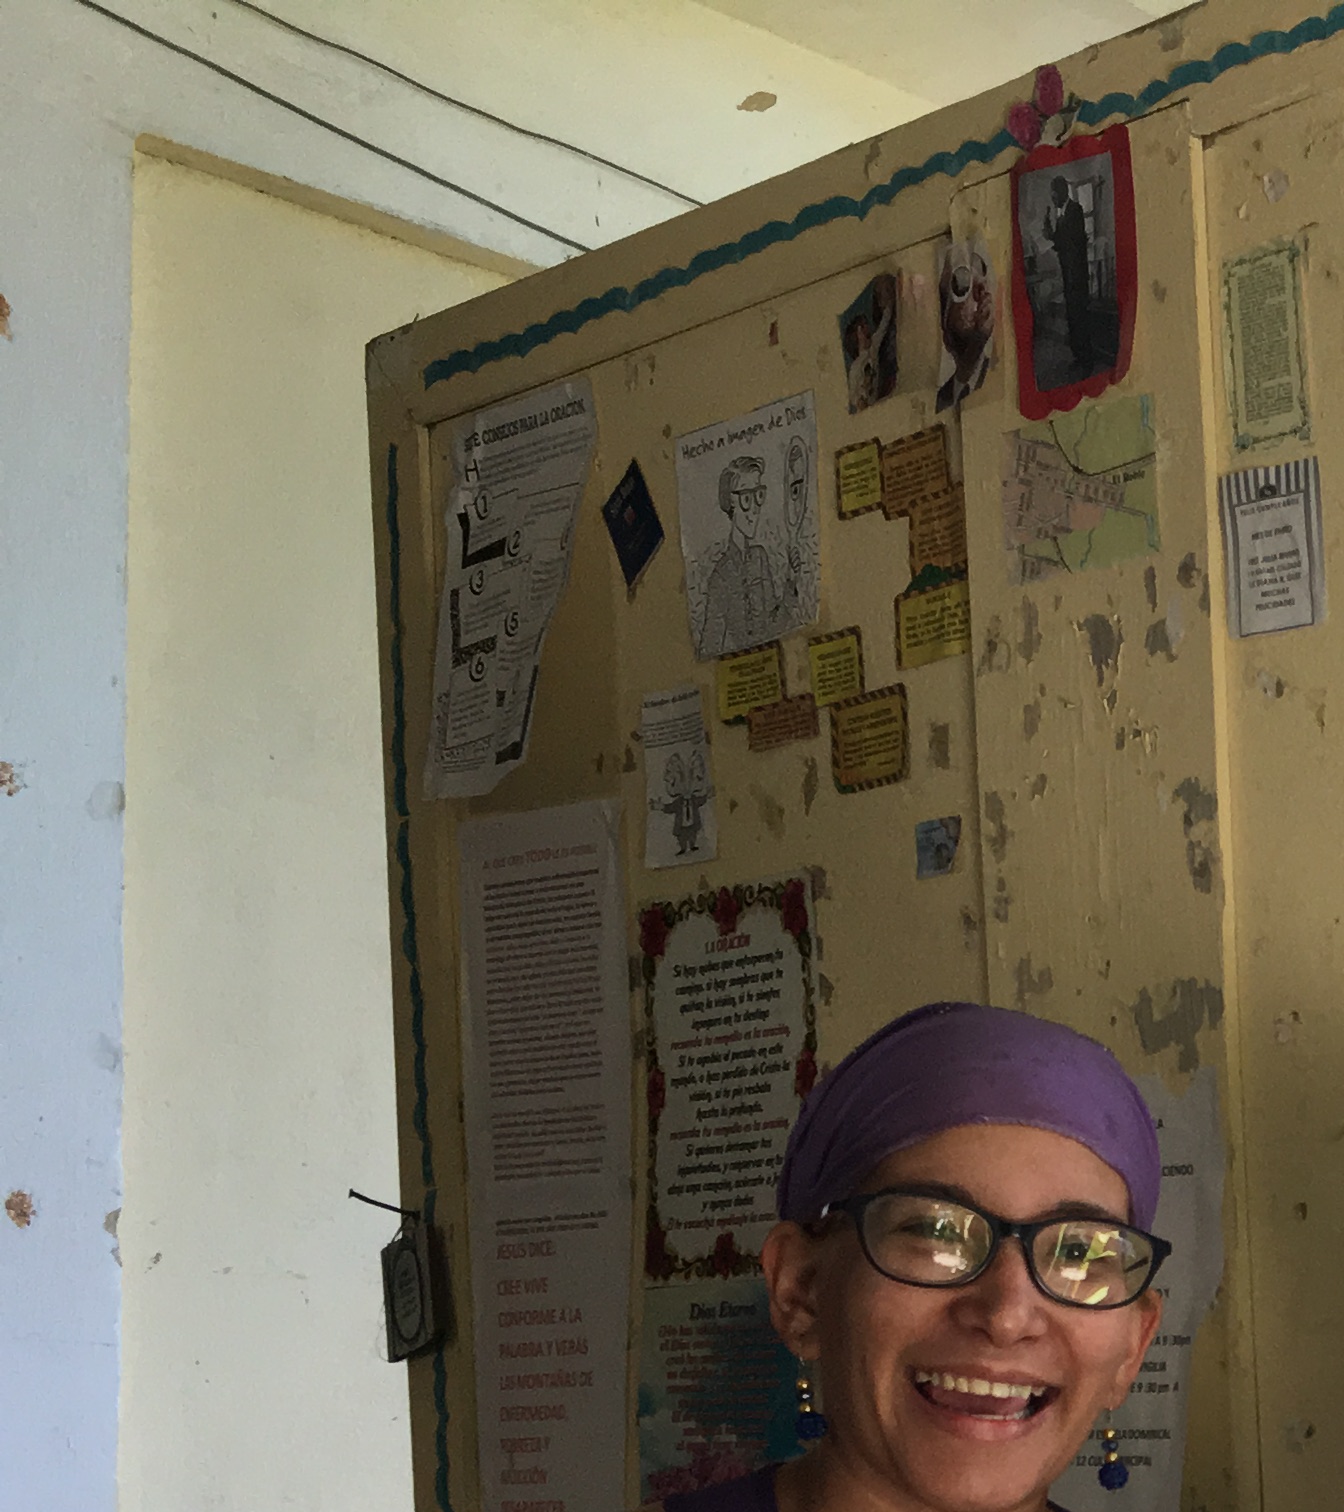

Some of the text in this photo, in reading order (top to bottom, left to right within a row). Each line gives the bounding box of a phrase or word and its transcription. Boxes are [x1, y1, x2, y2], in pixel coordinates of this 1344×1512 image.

[681, 438, 714, 459] Hecho
[768, 414, 783, 430] de
[785, 406, 806, 426] Dios
[464, 458, 480, 482] H
